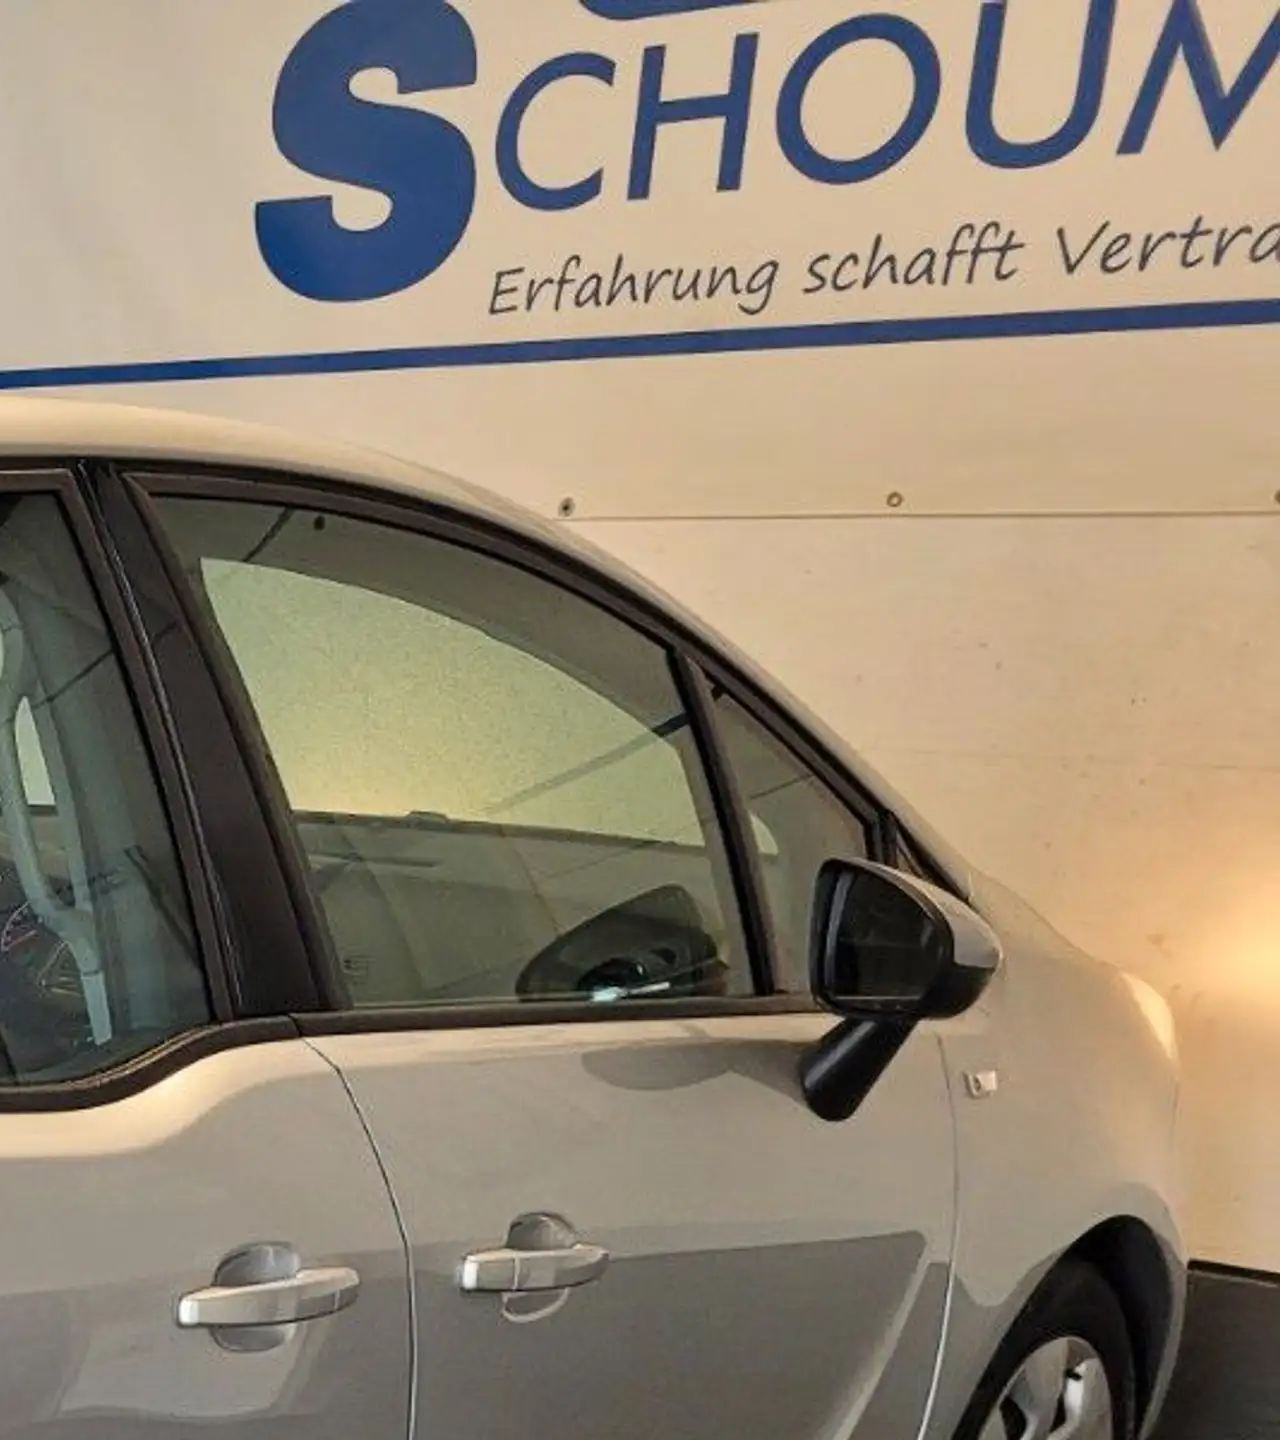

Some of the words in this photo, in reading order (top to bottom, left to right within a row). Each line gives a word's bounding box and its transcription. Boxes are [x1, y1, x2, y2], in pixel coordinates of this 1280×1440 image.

[488, 252, 781, 317] Erfahrung
[800, 220, 1027, 296] schafft
[1056, 214, 1280, 276] Vertra
